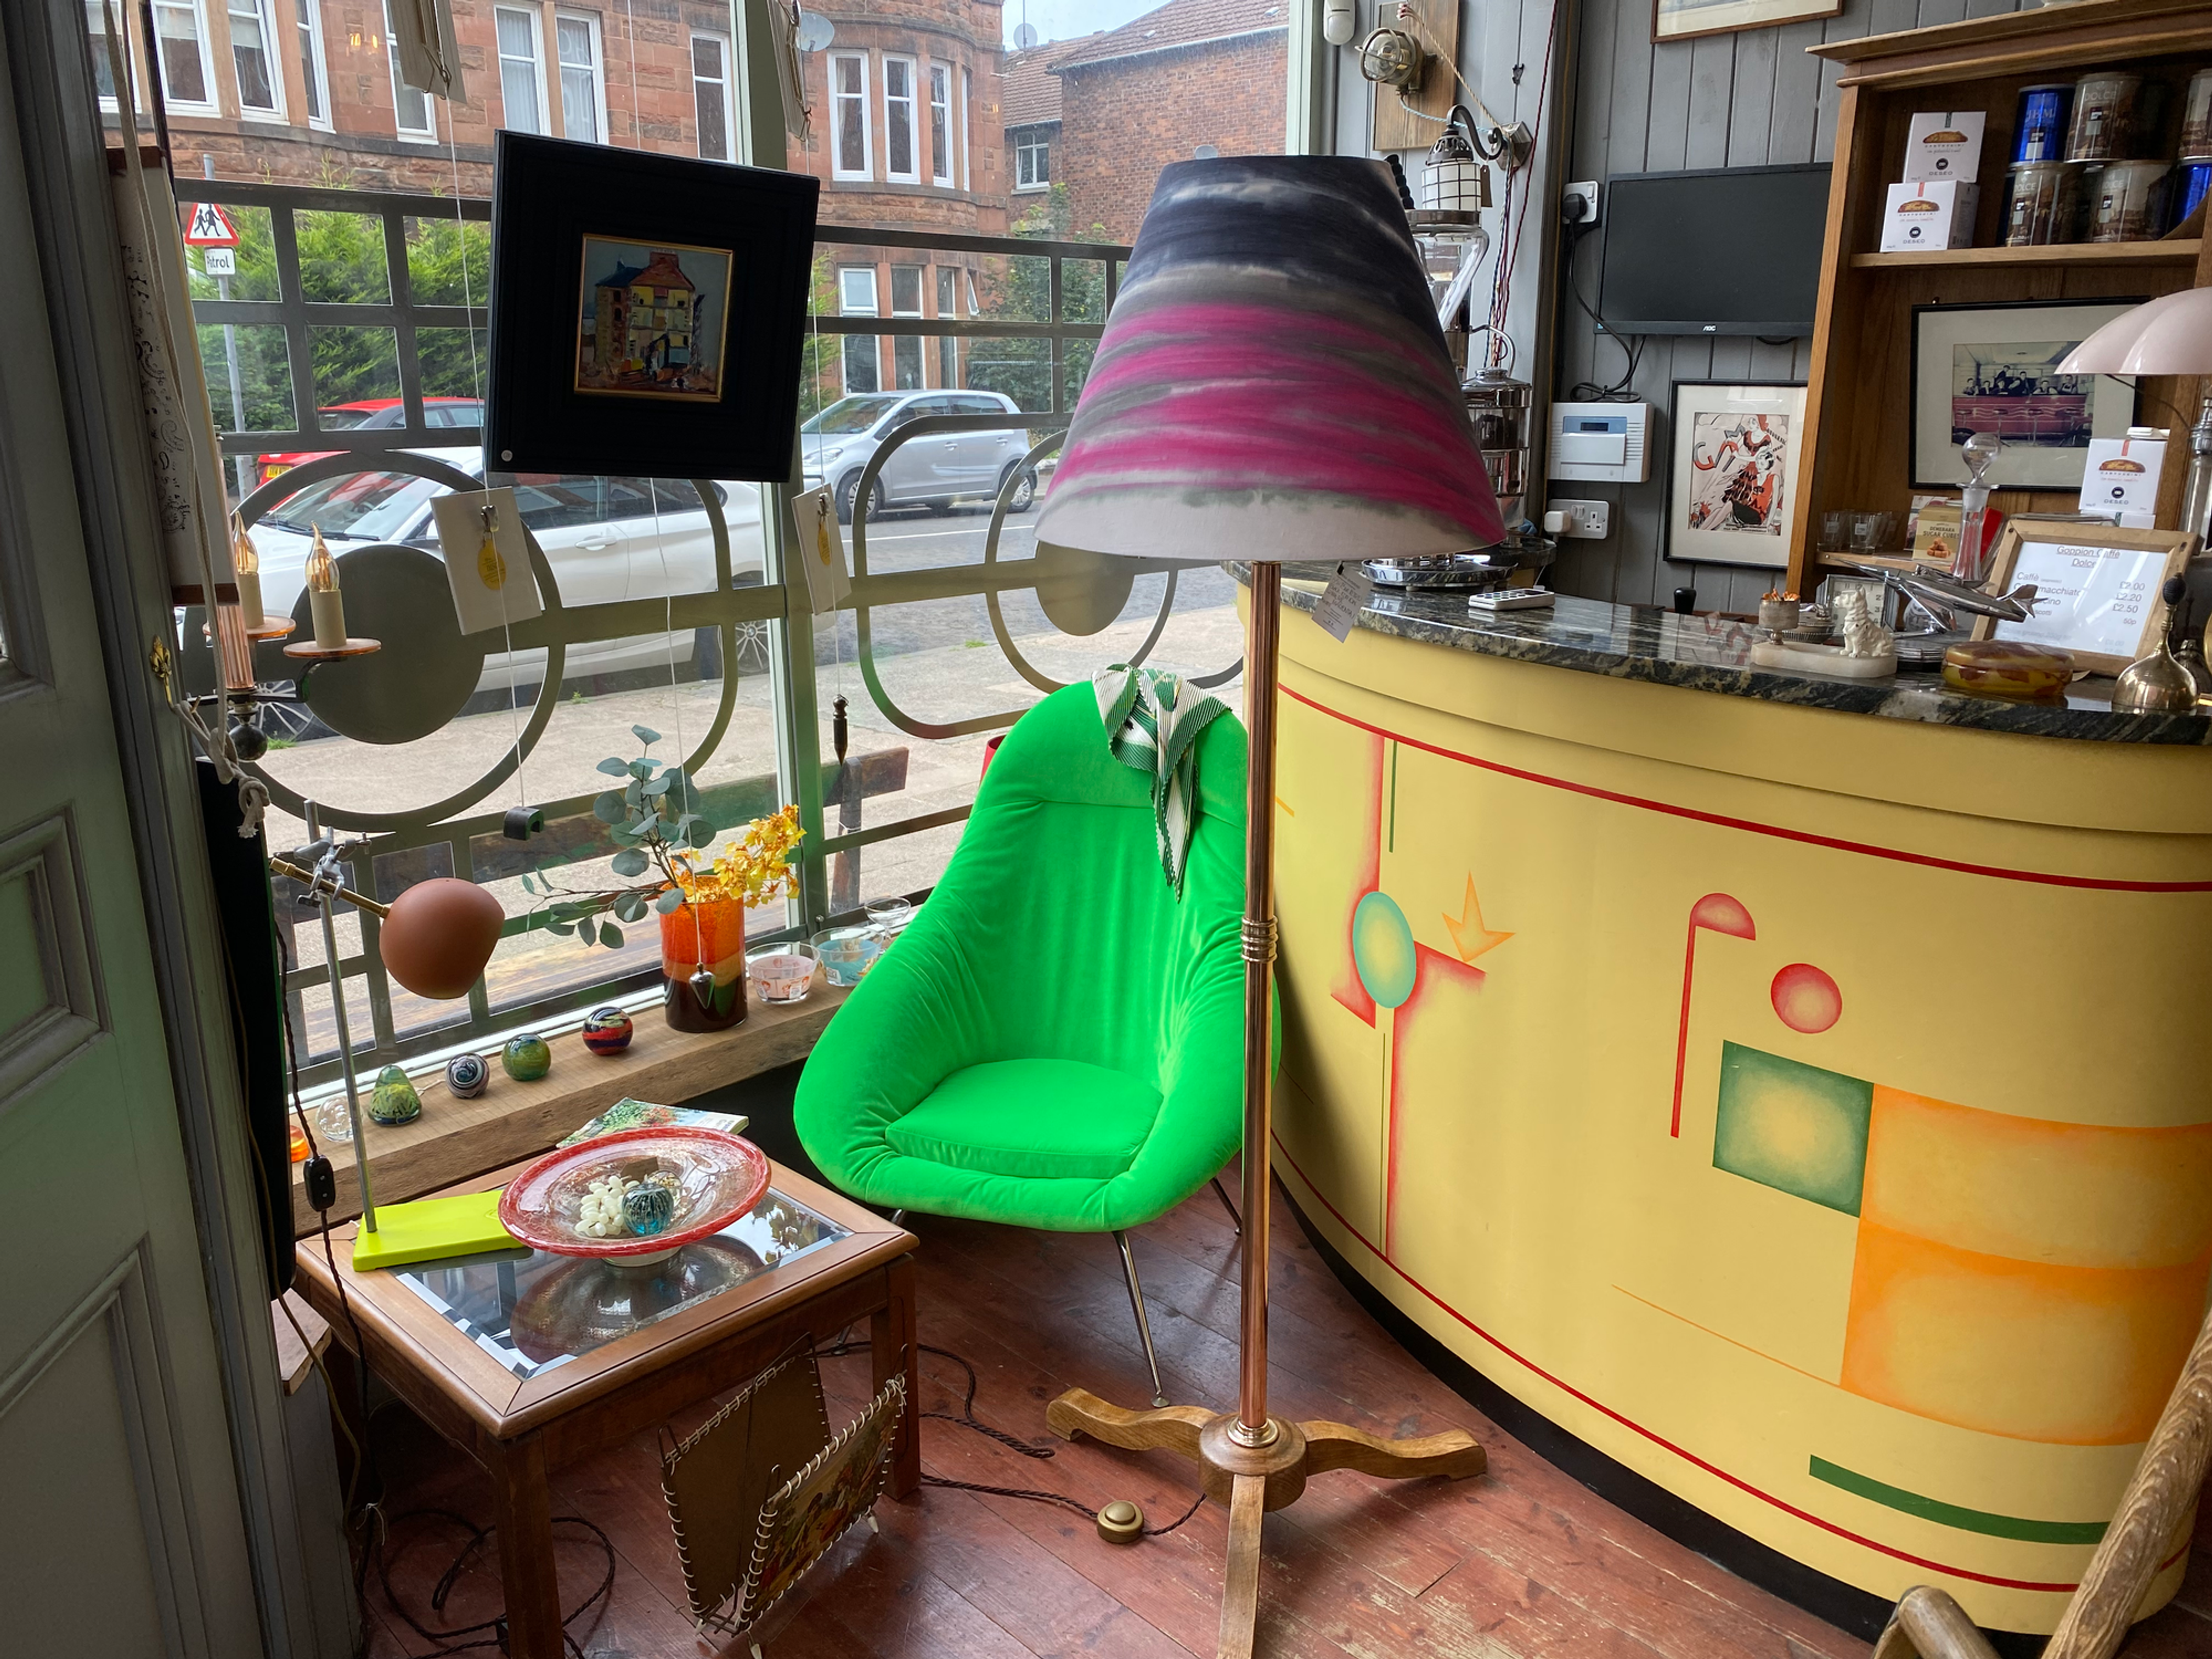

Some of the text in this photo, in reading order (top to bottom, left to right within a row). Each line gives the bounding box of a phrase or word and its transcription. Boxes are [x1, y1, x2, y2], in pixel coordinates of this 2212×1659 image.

[2056, 545, 2095, 556] Goppion
[2115, 592, 2142, 602] £2.20
[2112, 603, 2139, 614] £2.50
